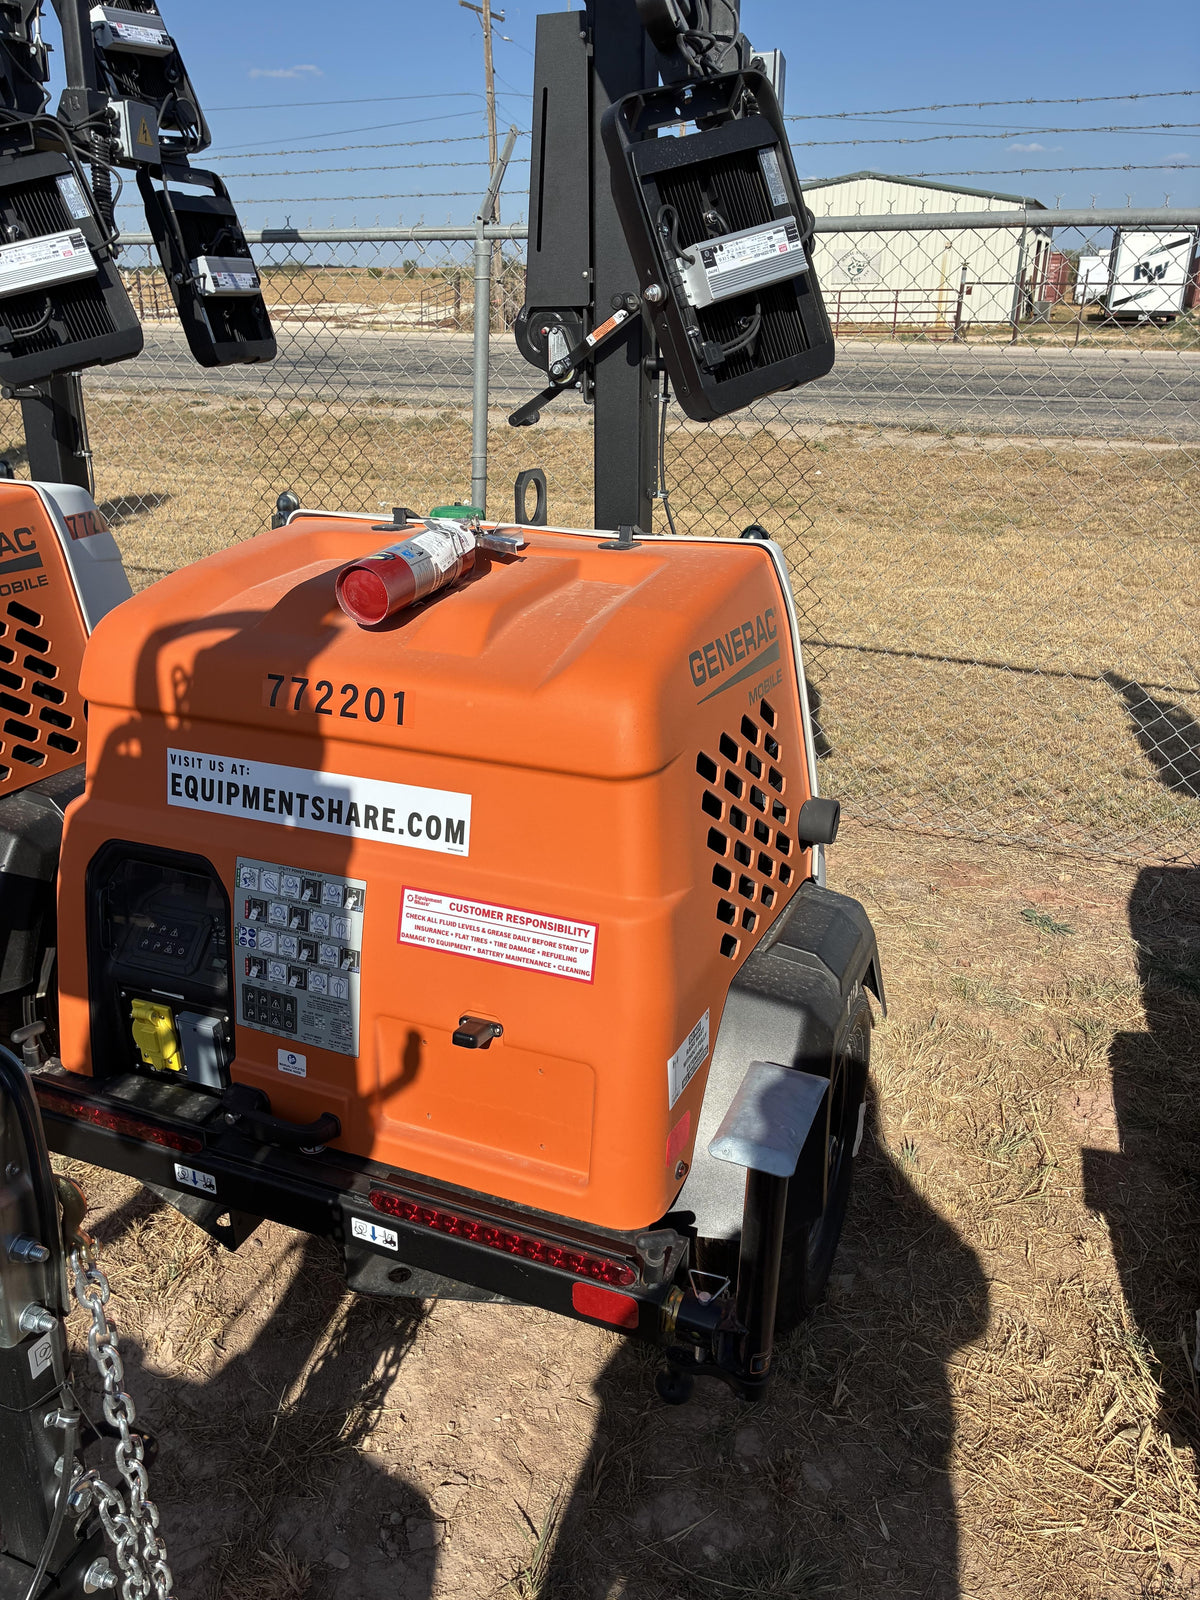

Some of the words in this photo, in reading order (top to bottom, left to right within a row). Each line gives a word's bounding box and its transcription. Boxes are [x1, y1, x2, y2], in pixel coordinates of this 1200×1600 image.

[688, 608, 777, 687] GENERAC
[267, 673, 406, 726] 772201
[748, 668, 782, 706] MOBILE
[170, 754, 202, 769] VISIT
[209, 759, 224, 772] US
[231, 764, 250, 776] AT:
[171, 772, 466, 845] EQUIPMENTSHARE.COM
[405, 912, 425, 922] CHECK
[427, 916, 437, 924] ALL
[439, 919, 456, 928] FLUID
[457, 922, 480, 933] LEVELS
[487, 928, 511, 939] GREASE
[512, 933, 530, 943] DAILY
[532, 937, 556, 949] BEFORE
[558, 943, 578, 953] START
[579, 947, 588, 955] UP
[449, 902, 503, 920] CUSTOMER
[506, 913, 590, 938] RESPONSIBILITY
[401, 931, 426, 942] DAMAGE
[436, 939, 471, 951] EQUIPMENT
[477, 947, 504, 958] BATTERY
[505, 953, 551, 968] MAINTENANCE
[557, 964, 590, 977] CLEANING
[414, 924, 449, 936] INSURANCE
[454, 932, 469, 940] FLAT
[470, 935, 487, 944] TIRES
[494, 940, 507, 948] TIRE
[508, 943, 535, 954] DAMAGE
[541, 950, 577, 963] REFUELING
